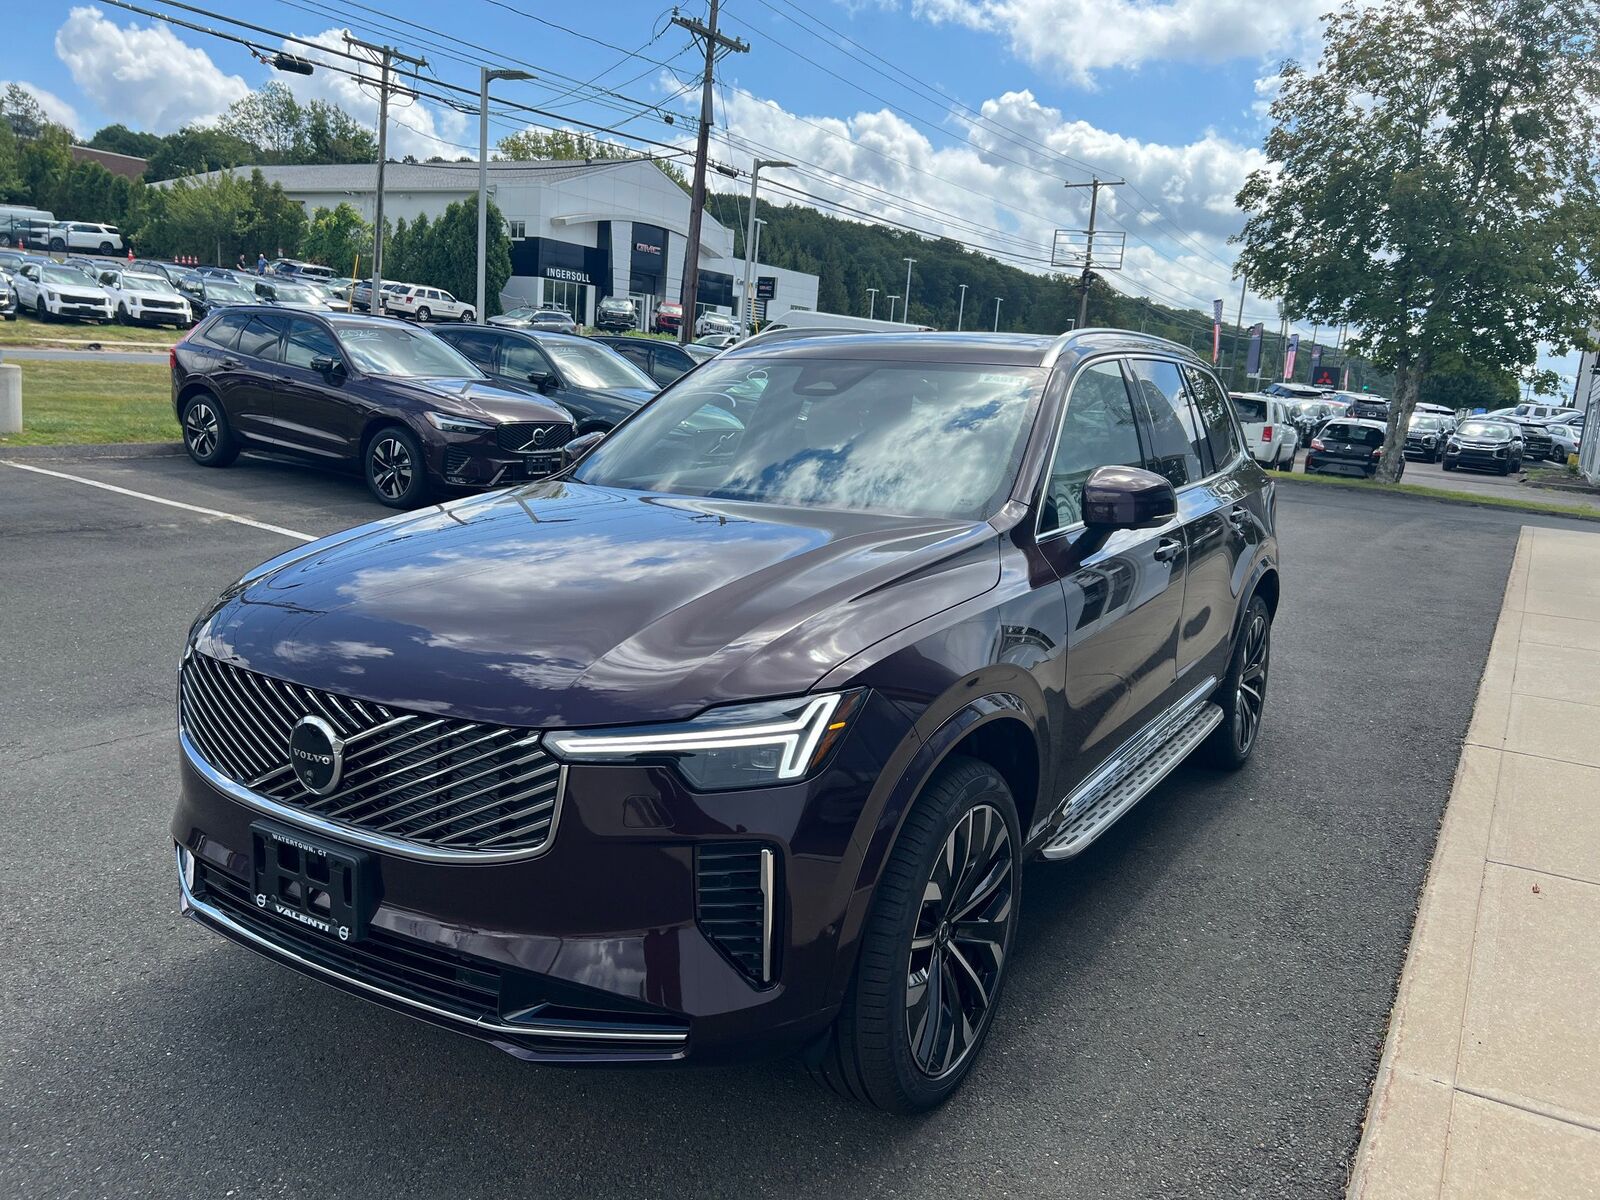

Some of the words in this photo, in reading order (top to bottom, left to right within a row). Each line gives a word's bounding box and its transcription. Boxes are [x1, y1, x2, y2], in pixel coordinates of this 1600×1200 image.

[636, 242, 661, 255] GMC
[546, 267, 591, 283] INGERSOLL
[293, 747, 330, 765] VOLVO
[271, 833, 316, 854] WATERTOWN,
[317, 849, 327, 857] CT
[275, 904, 329, 932] VALENTI
